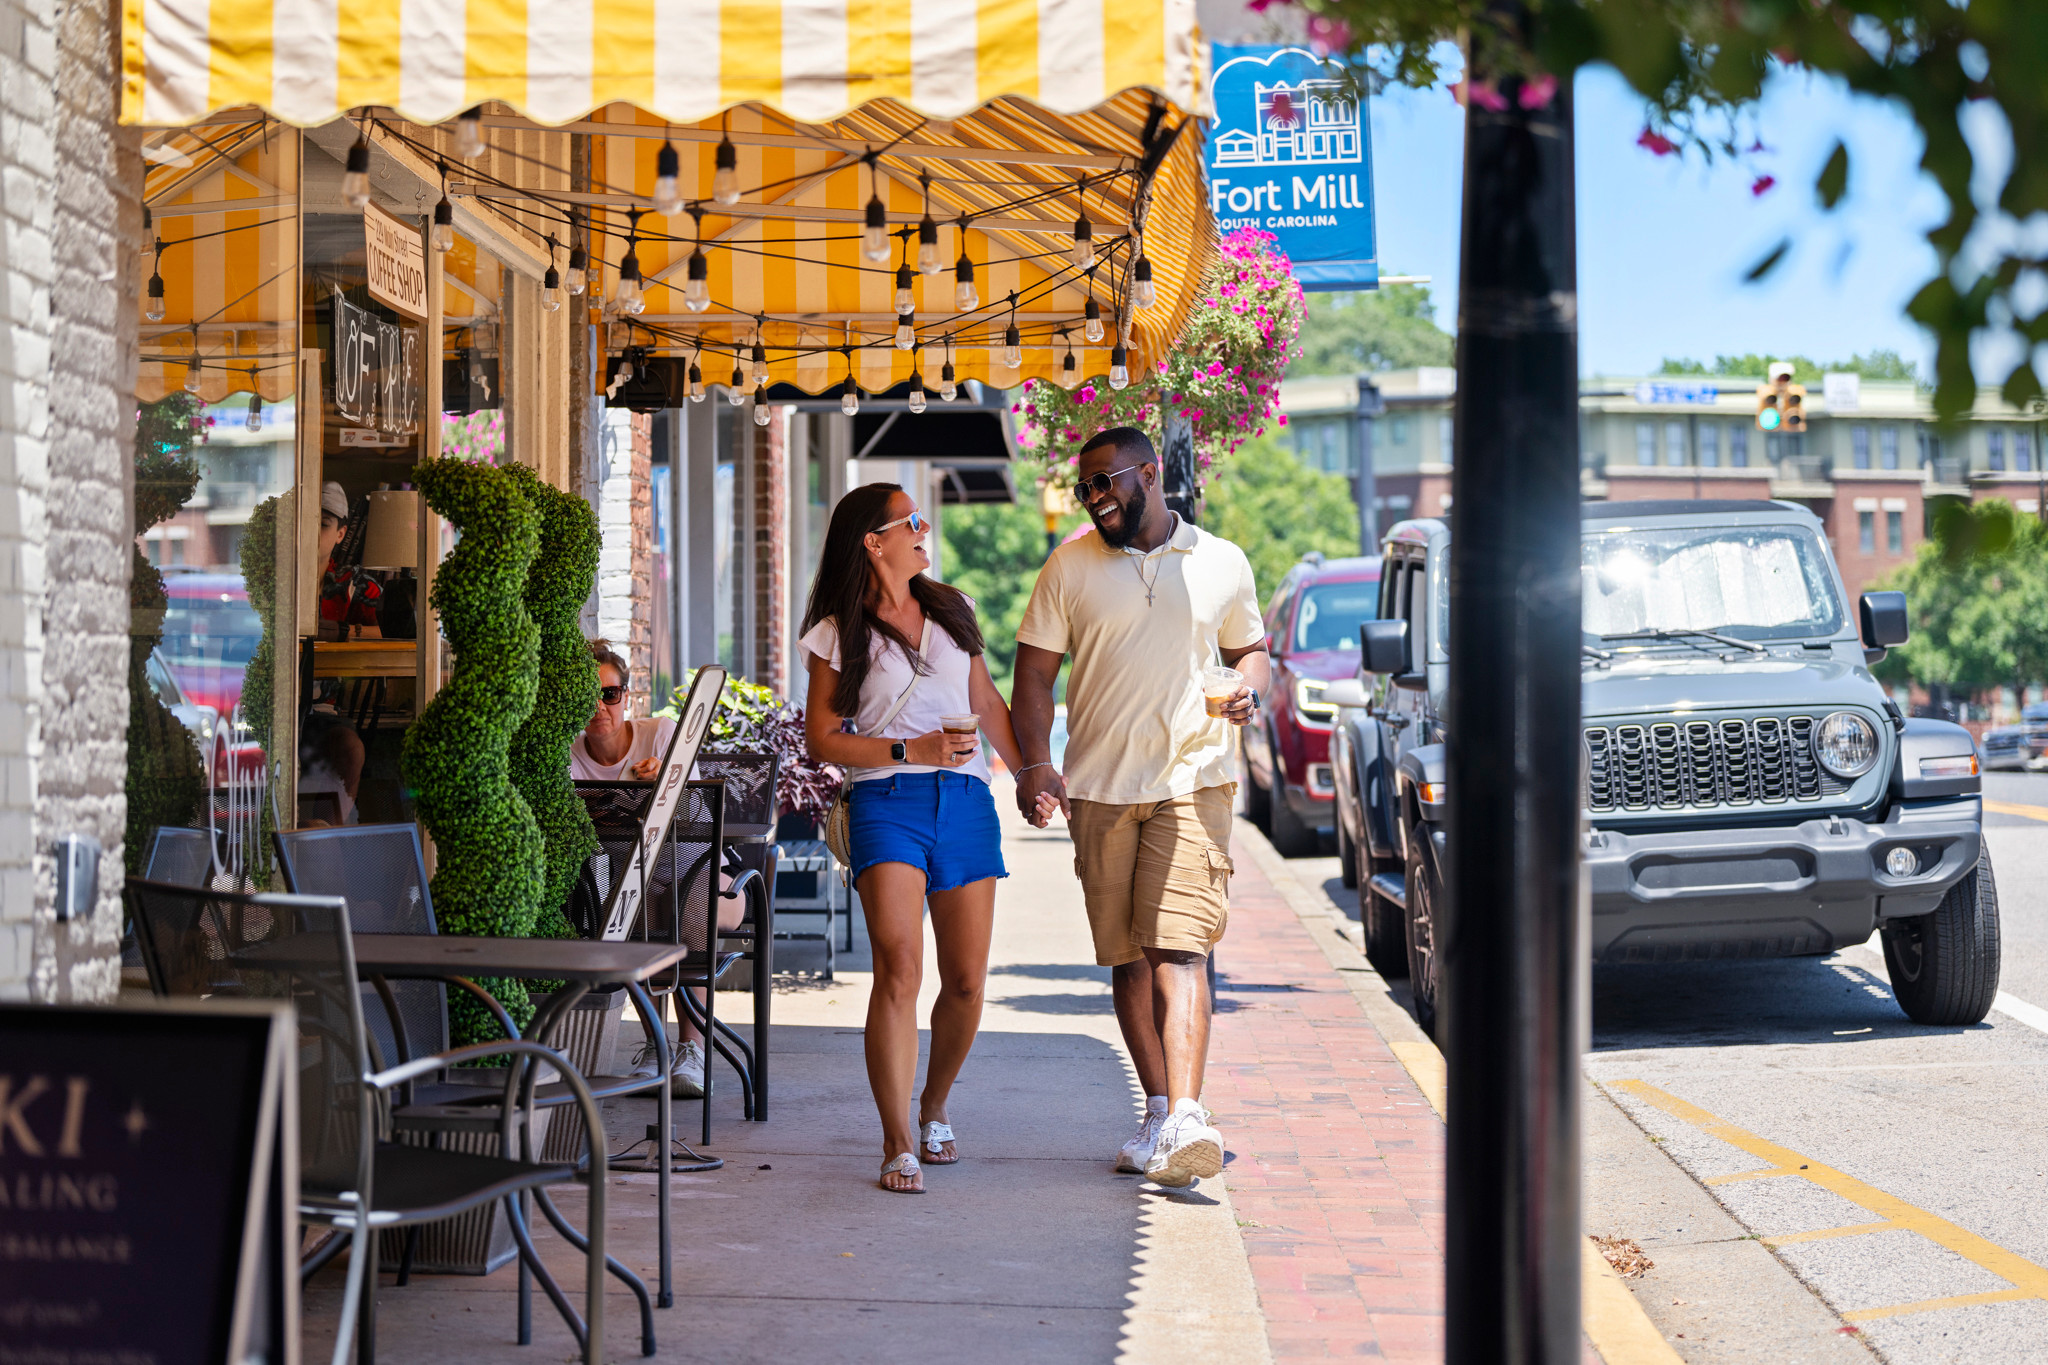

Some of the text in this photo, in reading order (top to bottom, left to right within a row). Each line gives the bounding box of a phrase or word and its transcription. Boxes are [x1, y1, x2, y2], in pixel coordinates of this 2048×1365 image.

[1212, 174, 1364, 213] Fort Mill
[375, 218, 384, 244] 229
[394, 230, 409, 259] Street
[1215, 215, 1337, 230] OUTH CAROLINA
[368, 241, 423, 307] COFFEE SHOP
[608, 702, 705, 934] OPEN
